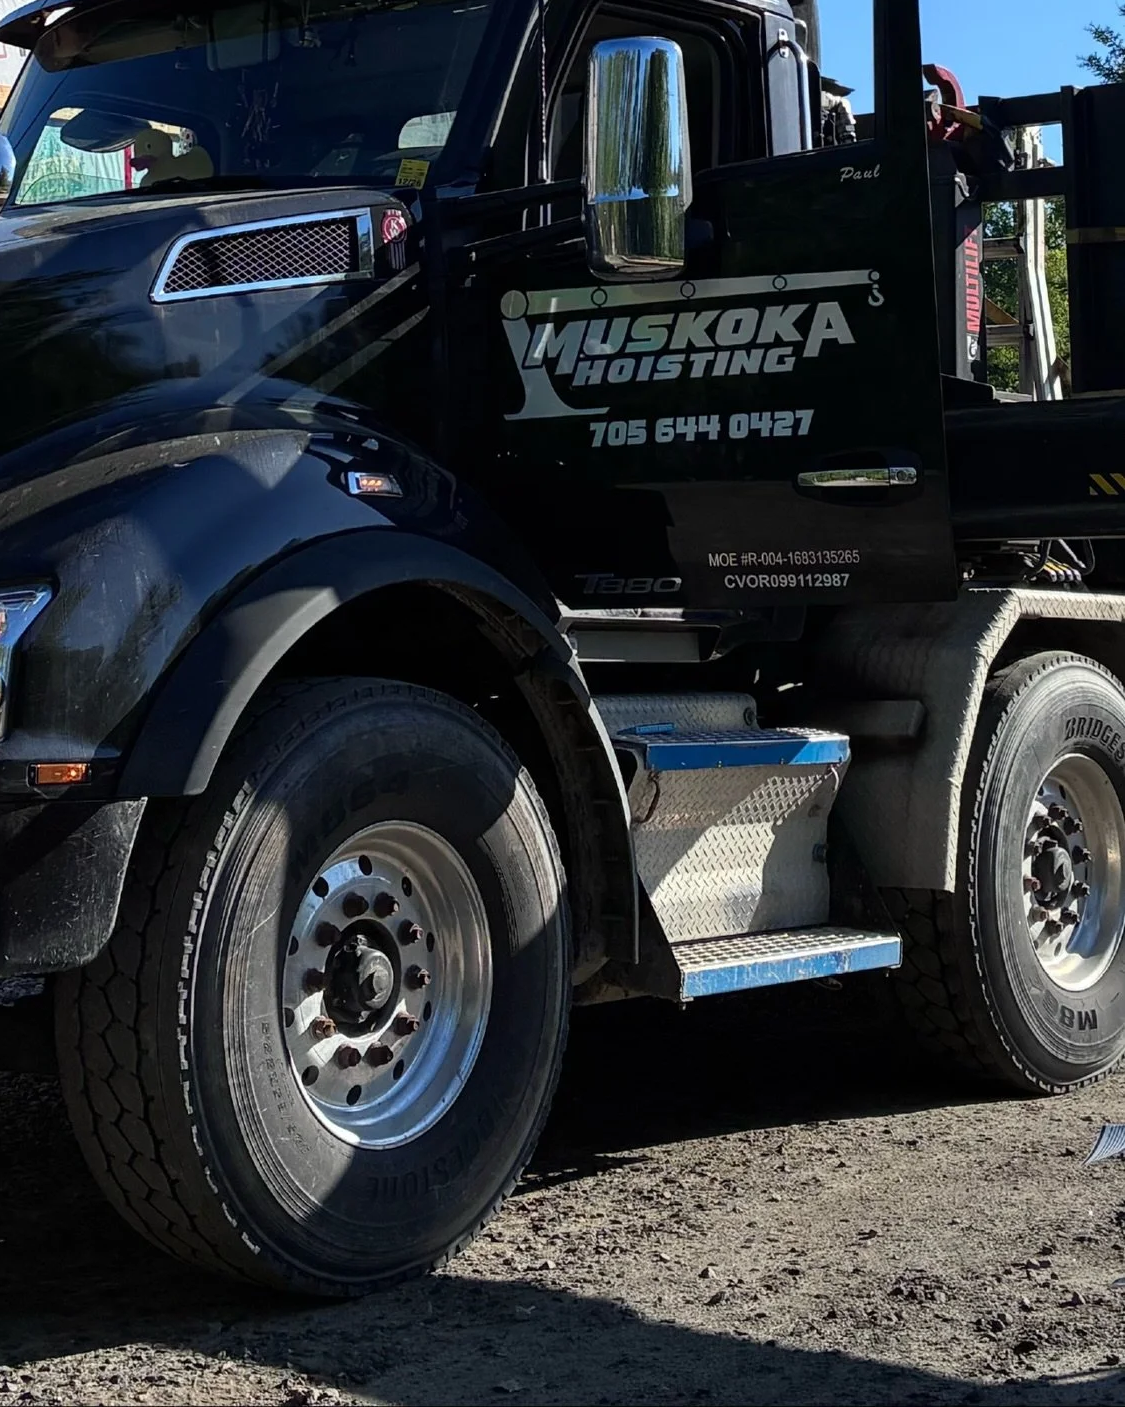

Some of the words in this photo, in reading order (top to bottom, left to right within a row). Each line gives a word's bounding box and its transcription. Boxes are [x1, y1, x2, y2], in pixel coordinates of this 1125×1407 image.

[840, 163, 881, 182] Paul
[525, 301, 856, 376] MUSKOKA
[572, 346, 796, 386] HOISTING
[589, 419, 647, 447] 705
[655, 414, 720, 442] 644
[729, 409, 815, 439] 0427
[708, 552, 738, 567] MOE
[741, 549, 860, 567] #R-004-1683135265
[574, 573, 682, 595] T880
[724, 573, 850, 589] CVOR099112987
